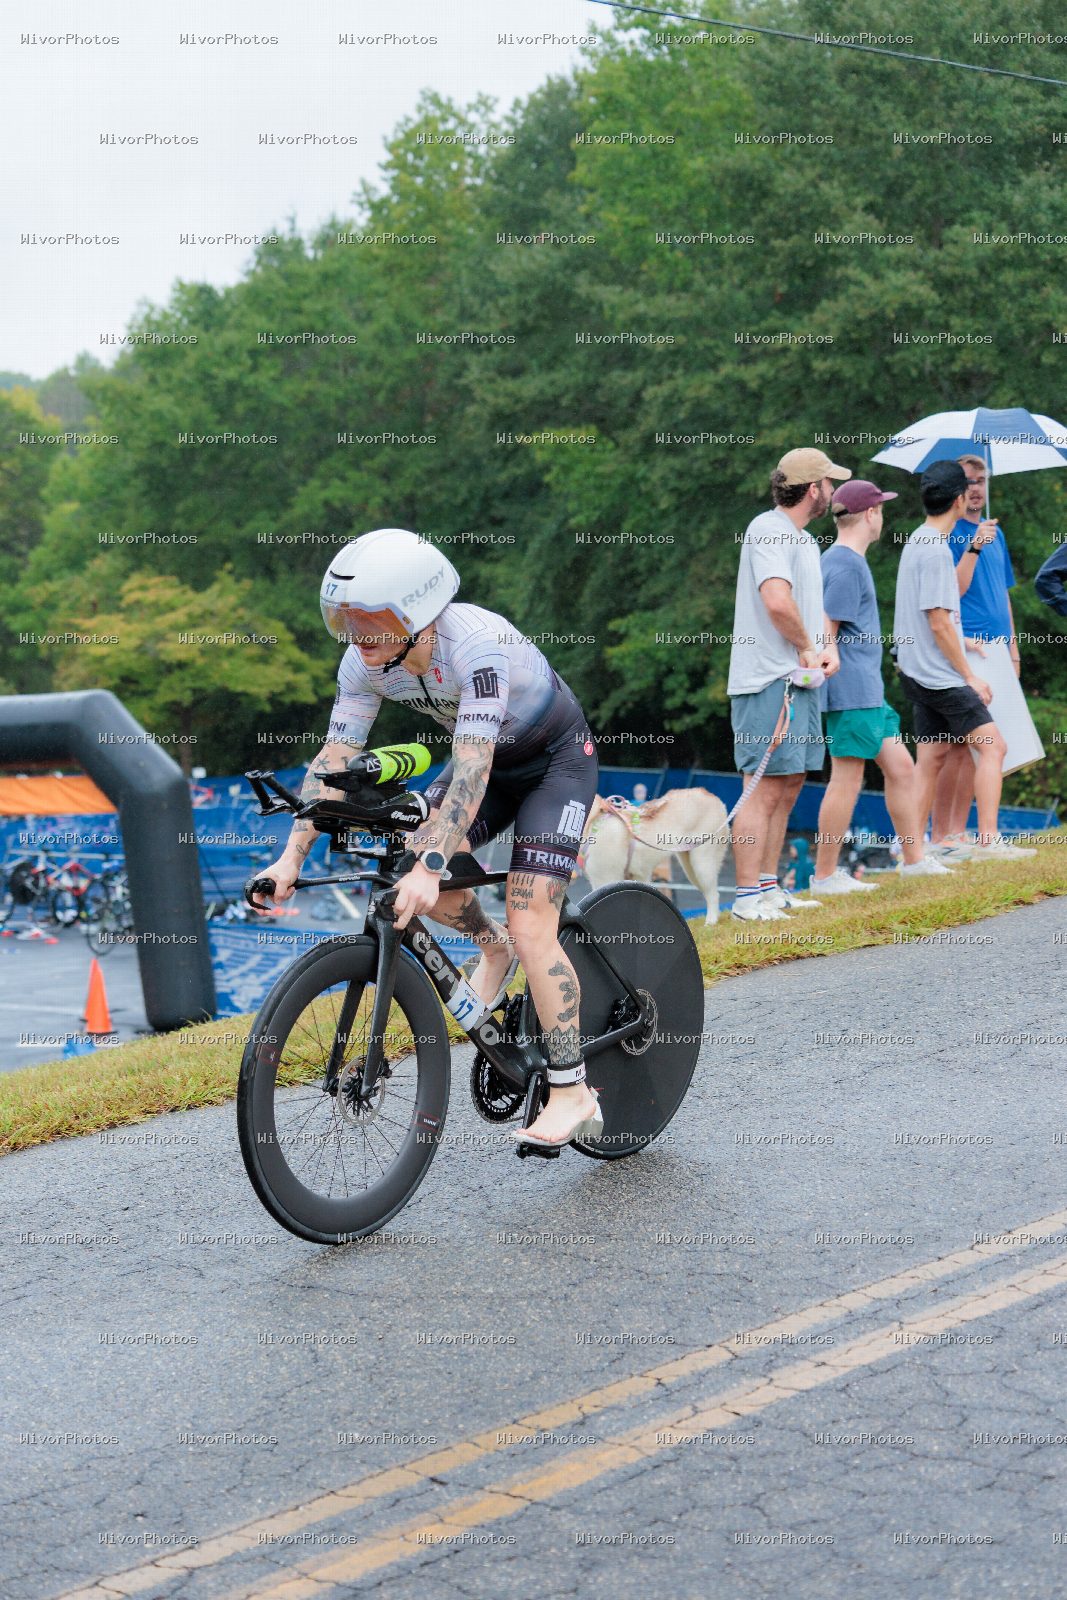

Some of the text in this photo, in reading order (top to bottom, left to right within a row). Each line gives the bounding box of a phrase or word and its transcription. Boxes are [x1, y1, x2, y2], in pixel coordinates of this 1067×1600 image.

[325, 582, 338, 597] 17
[400, 565, 444, 608] RUDY
[452, 998, 474, 1021] 17
